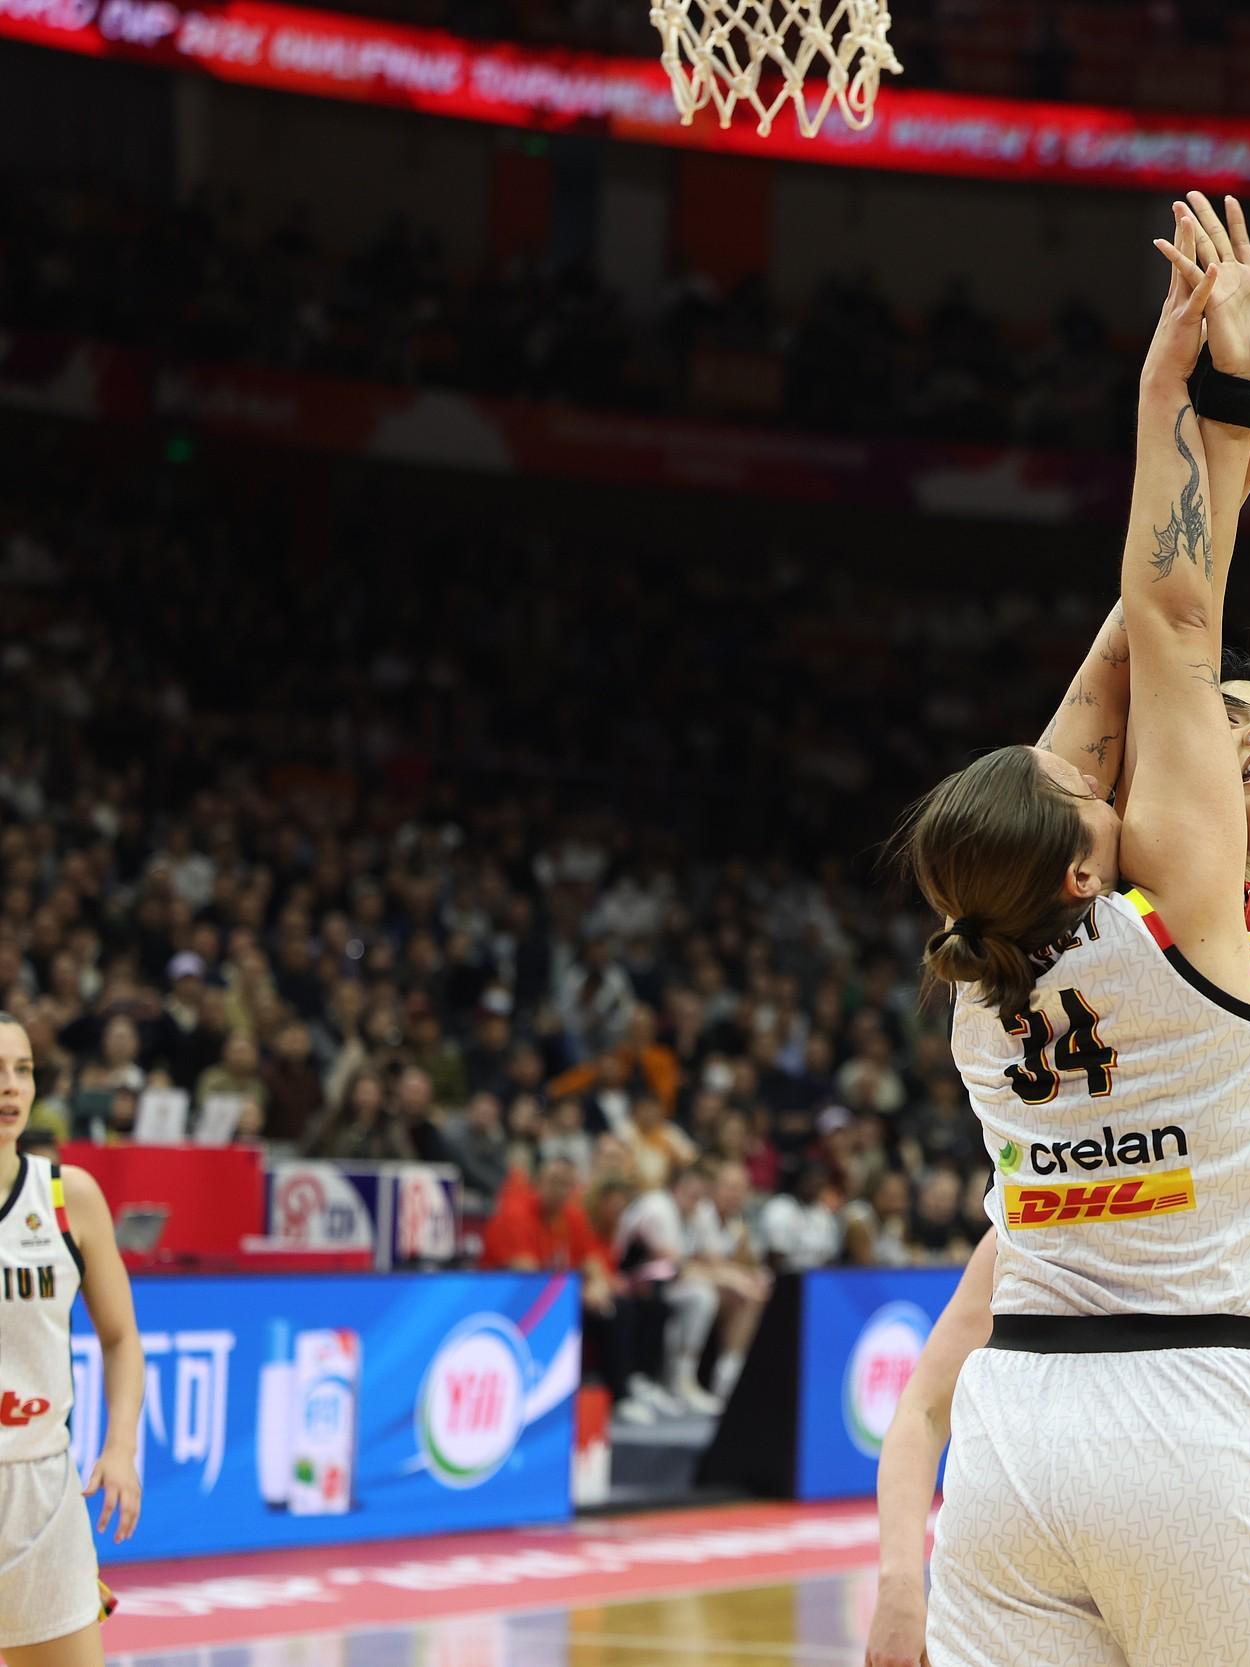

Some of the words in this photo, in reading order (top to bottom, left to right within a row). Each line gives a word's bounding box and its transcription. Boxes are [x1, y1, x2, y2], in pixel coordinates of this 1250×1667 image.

[1003, 988, 1118, 1105] 34
[1030, 1125, 1188, 1175] crelan
[1019, 1181, 1156, 1224] DHL
